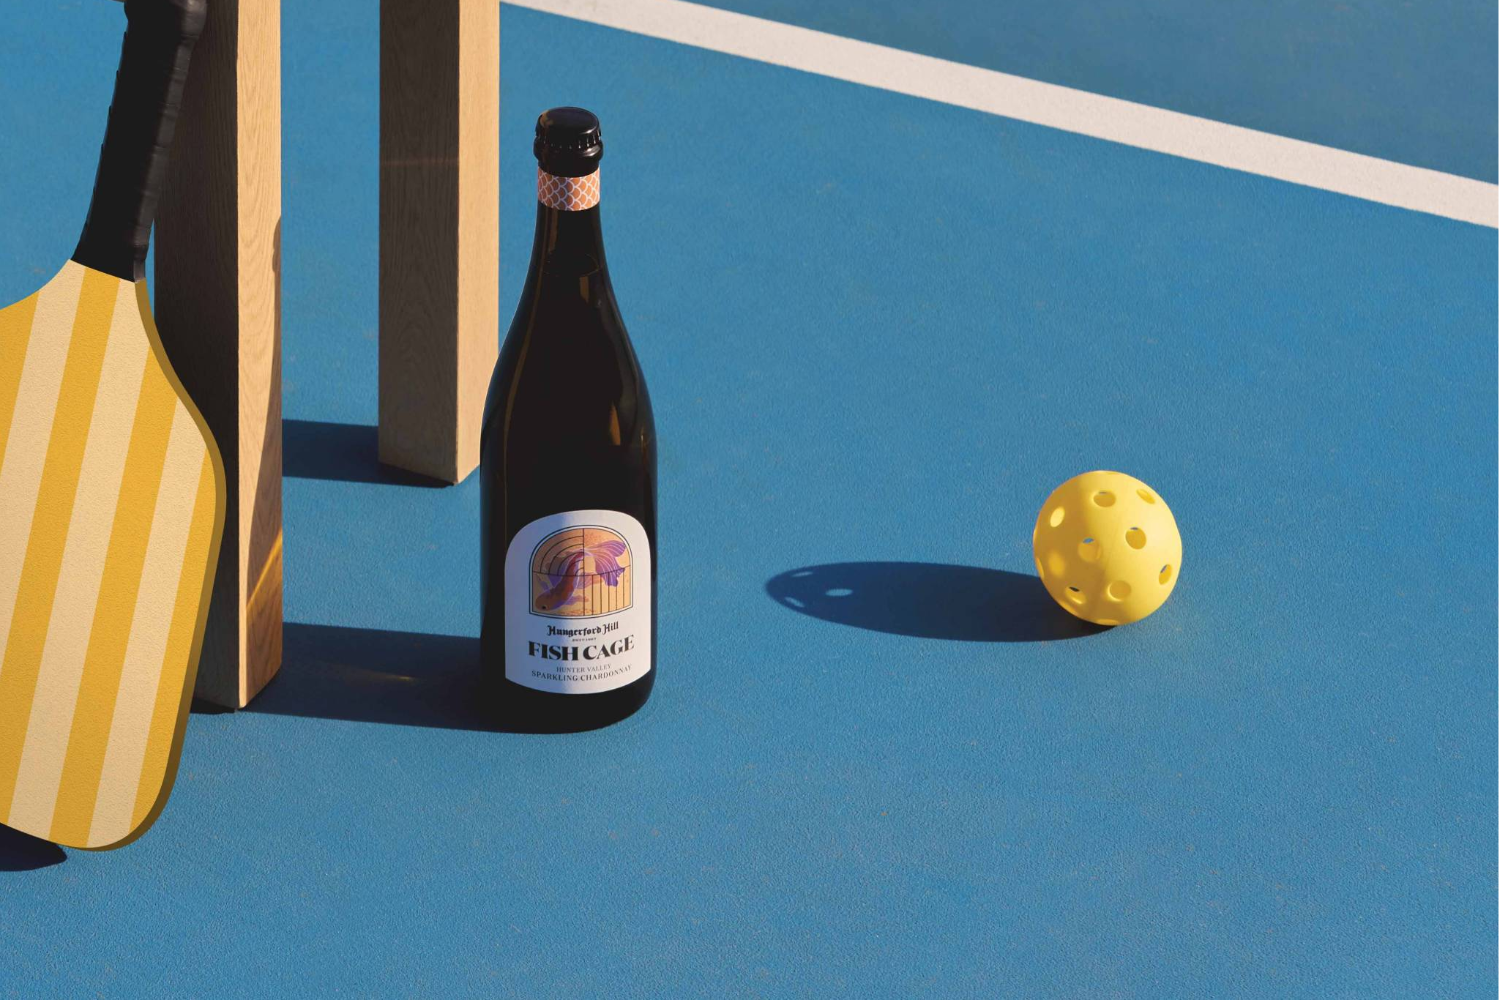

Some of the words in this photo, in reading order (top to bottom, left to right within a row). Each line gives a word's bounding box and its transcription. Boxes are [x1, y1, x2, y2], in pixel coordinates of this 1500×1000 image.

[547, 625, 602, 637] Hungerford
[602, 621, 619, 634] Hill
[529, 641, 579, 660] FISH
[583, 635, 635, 660] CAGE
[532, 671, 578, 681] SPARKLING
[580, 665, 632, 681] CHARDONNAY
[587, 664, 611, 672] VALLEY
